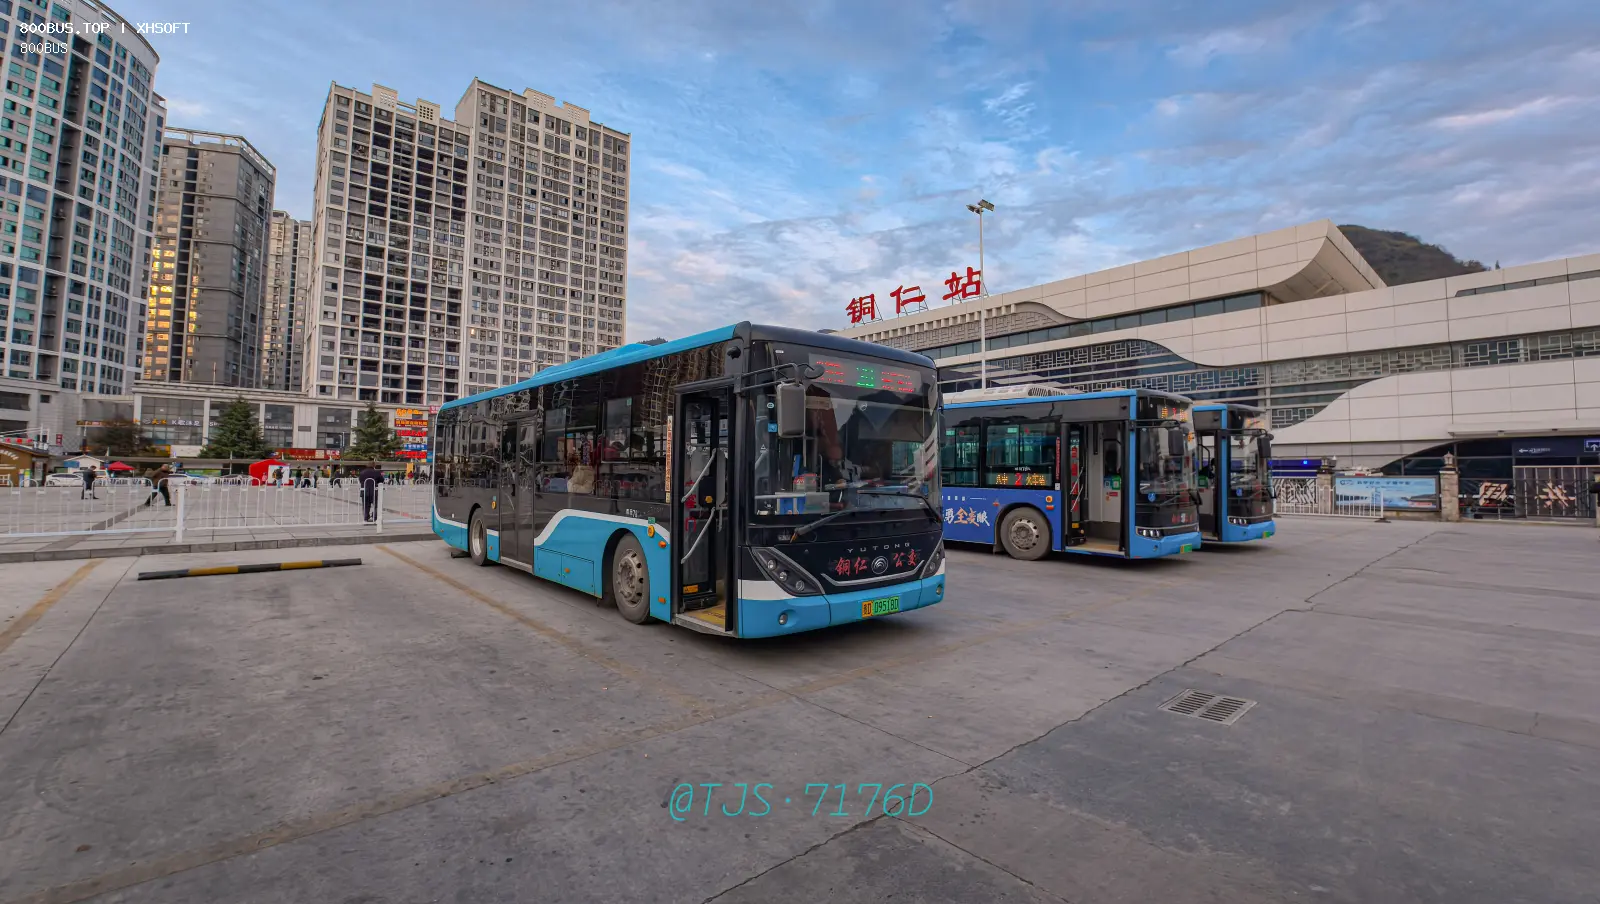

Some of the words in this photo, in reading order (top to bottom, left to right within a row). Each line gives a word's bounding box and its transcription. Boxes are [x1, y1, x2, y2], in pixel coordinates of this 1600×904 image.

[845, 266, 982, 324] 铜仁站
[847, 542, 911, 554] YUTONG
[835, 556, 868, 577] 铜仁
